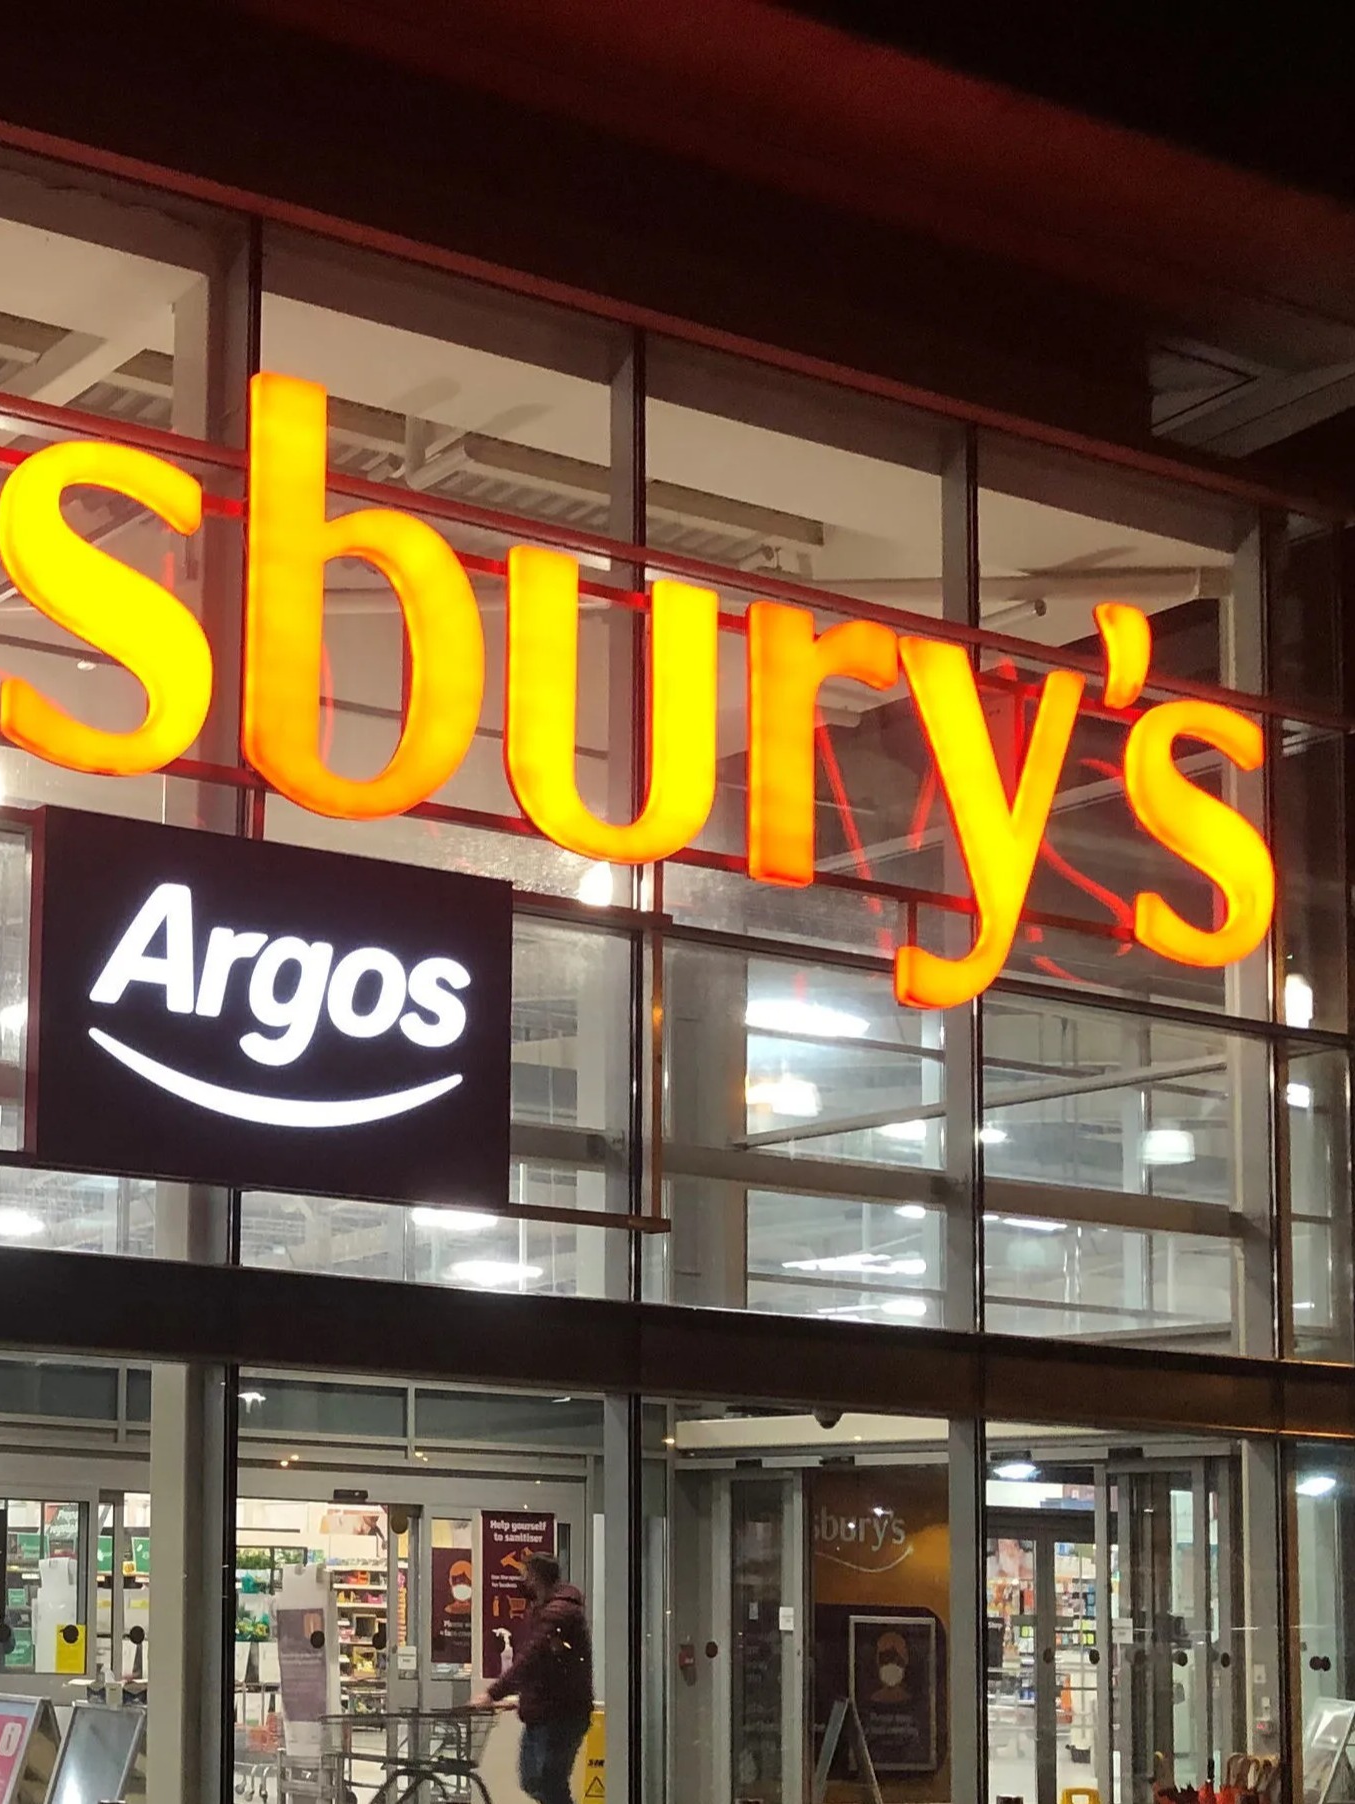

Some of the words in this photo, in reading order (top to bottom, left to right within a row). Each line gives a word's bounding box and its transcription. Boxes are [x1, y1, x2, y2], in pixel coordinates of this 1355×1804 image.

[89, 882, 472, 1067] Argos
[489, 1519, 510, 1531] Help
[511, 1520, 547, 1533] yourself
[493, 1532, 504, 1542] to
[504, 1532, 543, 1543] sanitiser
